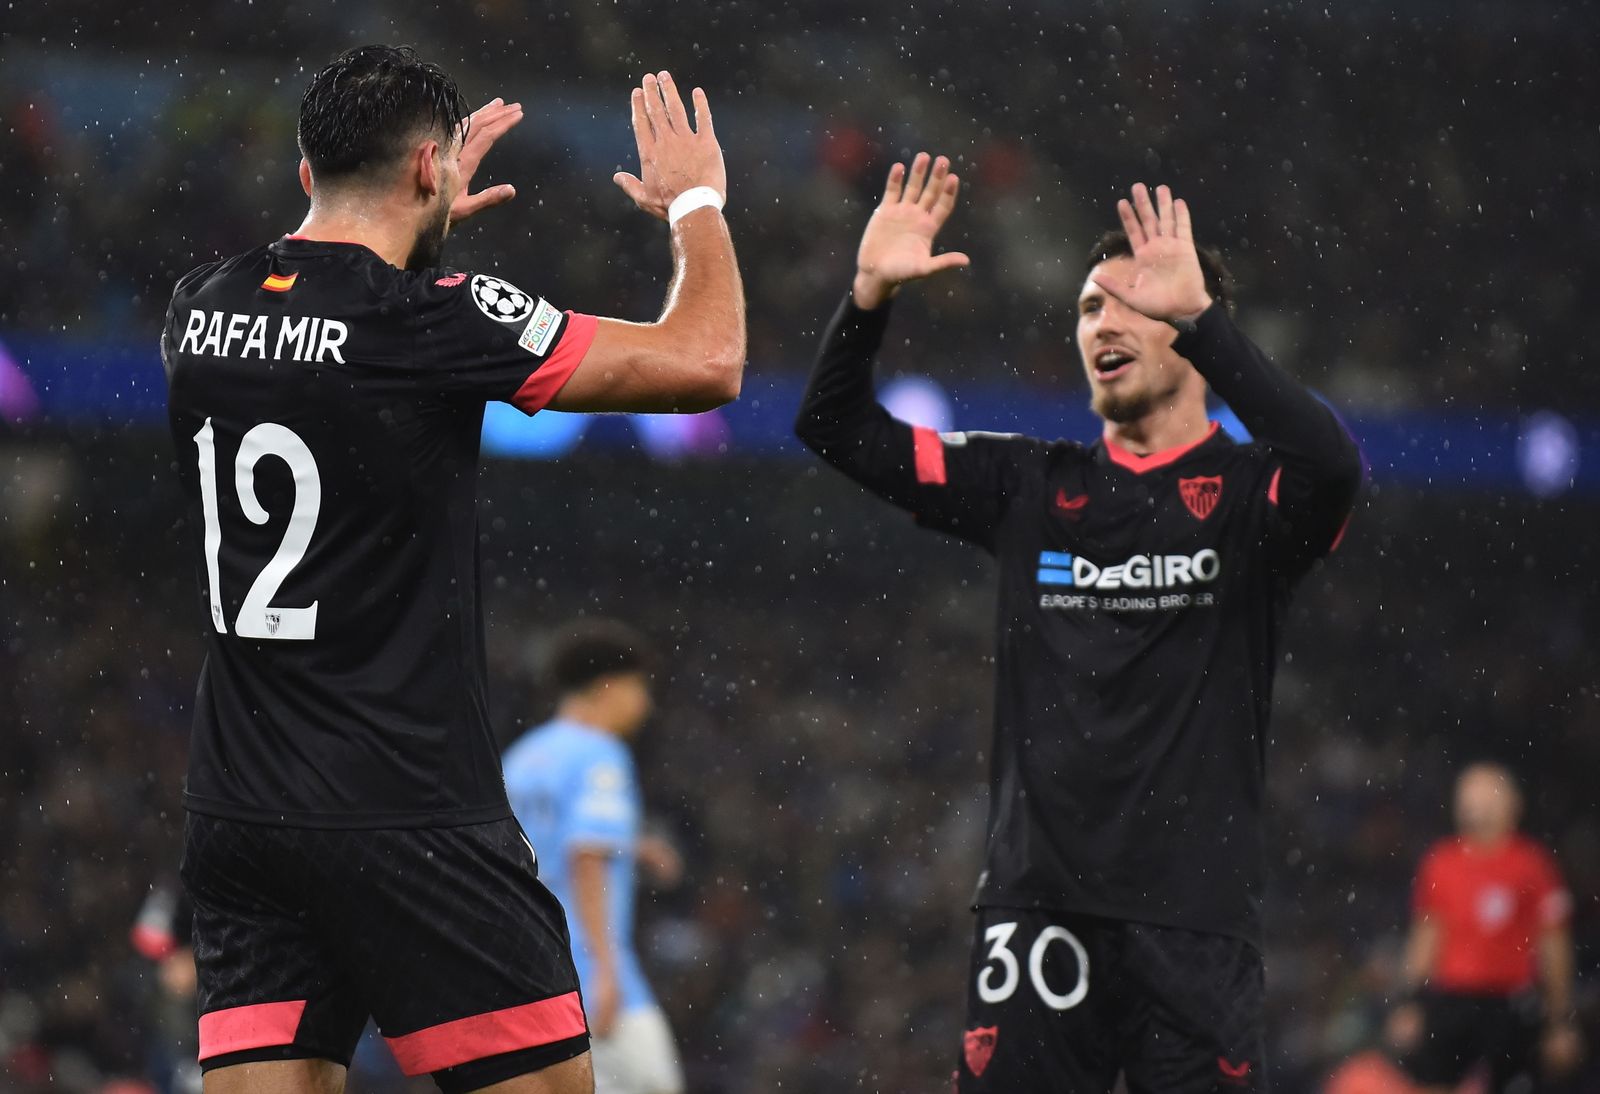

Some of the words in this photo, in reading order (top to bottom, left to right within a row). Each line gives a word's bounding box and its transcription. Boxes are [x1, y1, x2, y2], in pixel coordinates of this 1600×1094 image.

[178, 308, 269, 359] RAFA
[273, 314, 349, 365] MIR
[193, 416, 321, 640] 12
[1072, 548, 1221, 590] DEGIRO
[1101, 596, 1157, 611] EADING
[1159, 593, 1214, 608] BROER
[977, 921, 1090, 1011] 30
